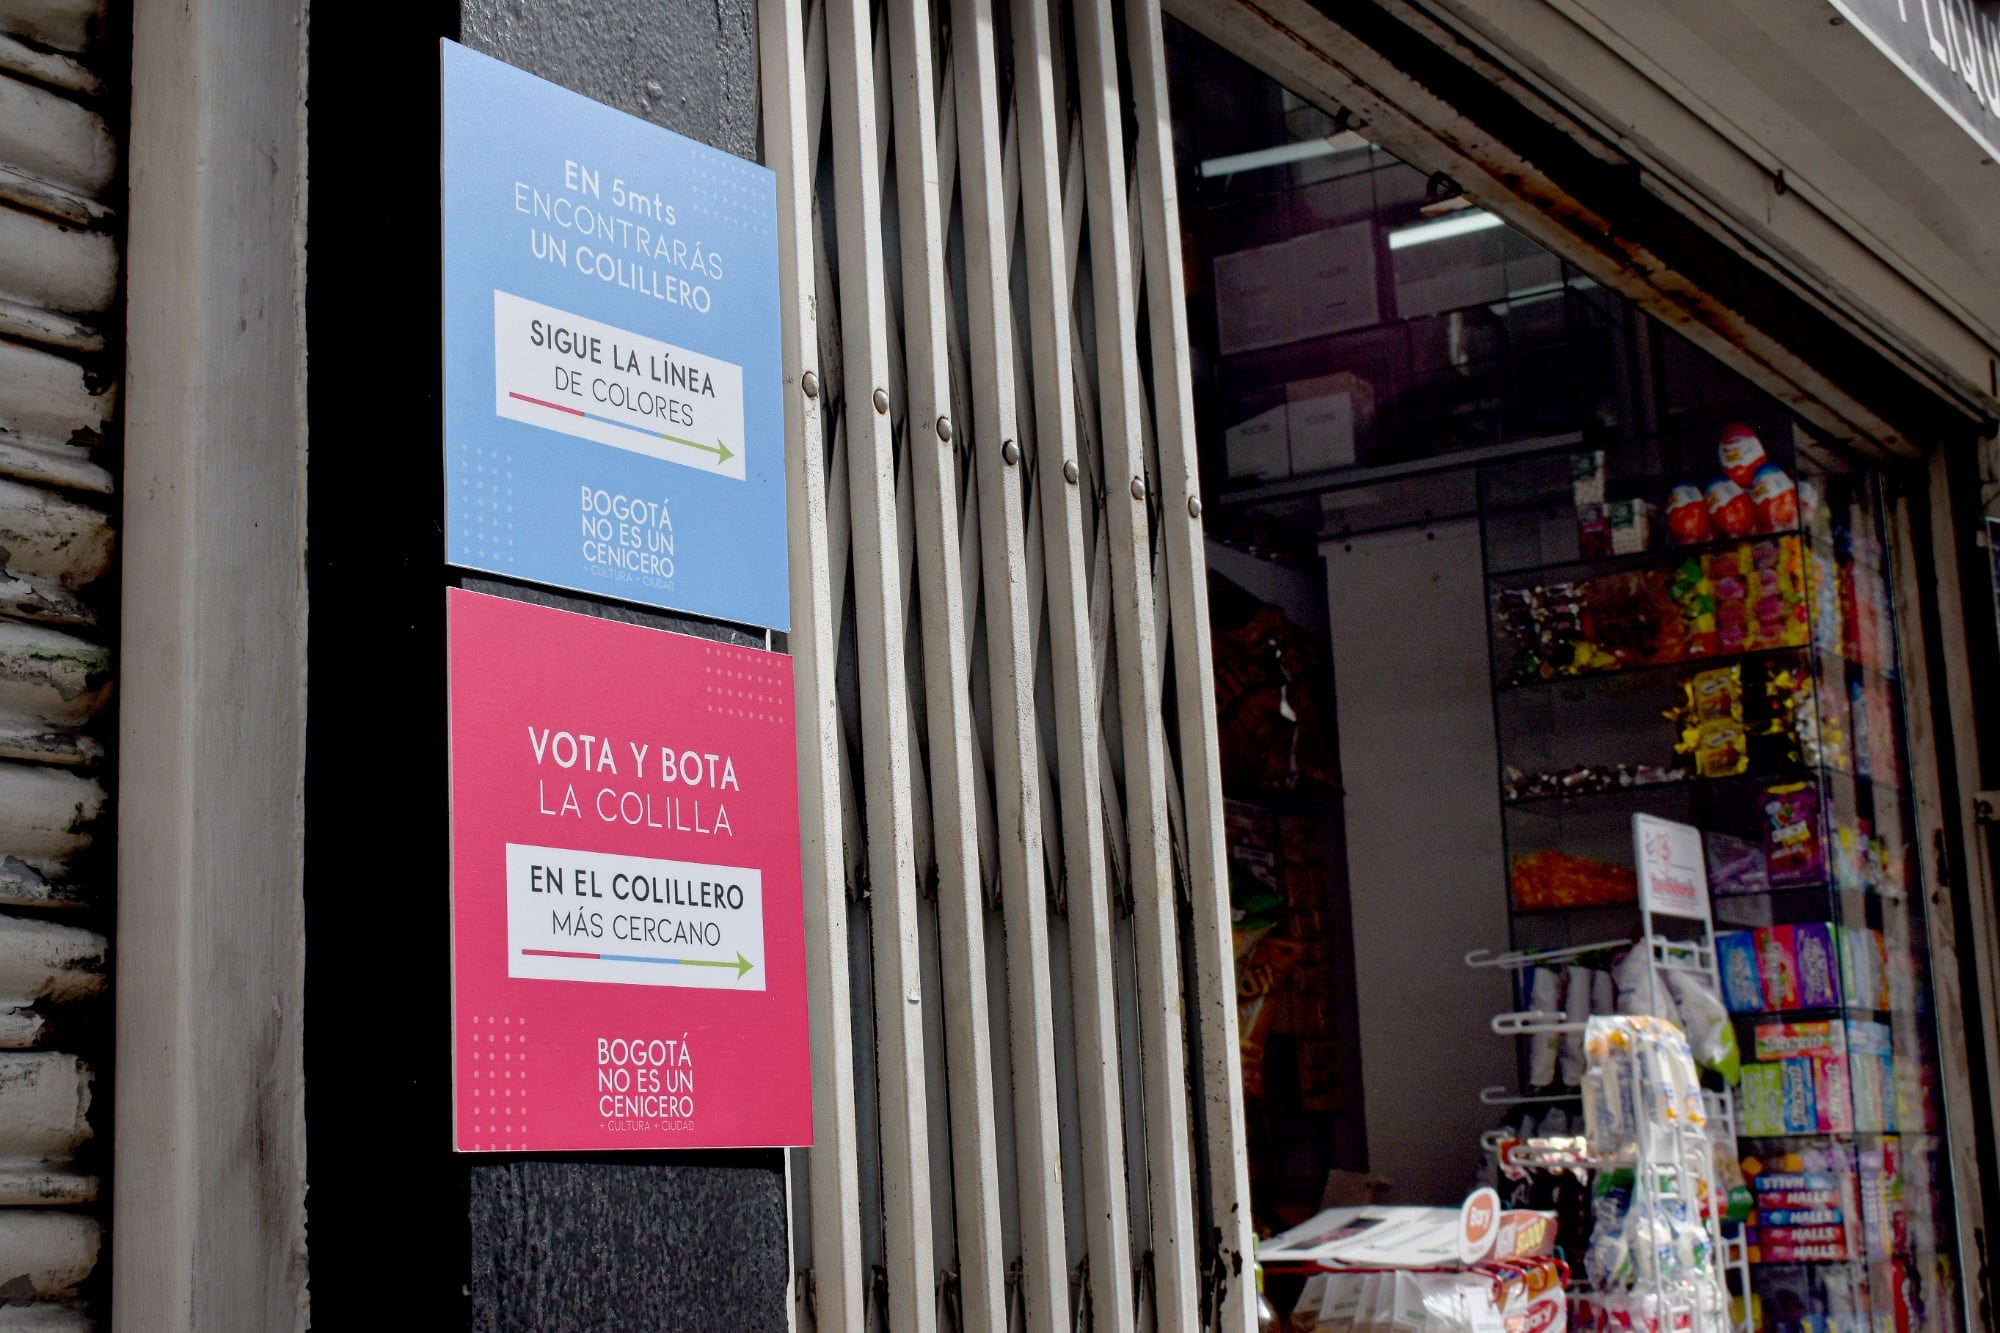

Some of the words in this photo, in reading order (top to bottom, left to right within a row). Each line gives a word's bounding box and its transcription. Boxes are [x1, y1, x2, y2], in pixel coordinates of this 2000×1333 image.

[566, 160, 600, 198] EN
[613, 179, 676, 225] 5mts
[516, 182, 723, 279] ENCONTRARÁS
[532, 229, 567, 266] UN
[576, 246, 711, 312] COLILLERO
[531, 320, 602, 364] SIGUE
[614, 344, 641, 376] LA
[650, 352, 717, 399] LÍNEA
[556, 366, 583, 396] DE
[593, 379, 694, 426] COLORES
[582, 485, 673, 530] BOGOTÁ
[583, 514, 613, 541] NO
[620, 524, 642, 548] ES
[648, 530, 674, 556] UN
[583, 541, 674, 577] CENICERO
[528, 727, 618, 774] VOTA
[630, 742, 649, 778] Y
[662, 747, 740, 791] BOTA
[540, 780, 582, 818] LA
[597, 788, 733, 836] COLILLA
[531, 865, 564, 895] EN
[575, 870, 603, 898] EL
[613, 874, 744, 910] COLILLERO
[553, 905, 605, 938] MÁS
[613, 915, 721, 946] CERCANO
[598, 1032, 693, 1067] BOGOTÁ
[1765, 1036, 1822, 1051] Trident
[599, 1068, 631, 1092] NO
[638, 1069, 661, 1093] ES
[667, 1070, 694, 1093] UN
[1791, 1065, 1807, 1127] Trident
[1826, 1063, 1843, 1123] Trident
[600, 1095, 694, 1117] CENICERO
[608, 1120, 651, 1131] CULTURA
[662, 1121, 695, 1131] CIUDAD
[1786, 1190, 1830, 1205] HALLS
[1790, 1209, 1832, 1223] HALLS
[1791, 1226, 1835, 1242] HALLS
[1793, 1244, 1837, 1260] HALLS
